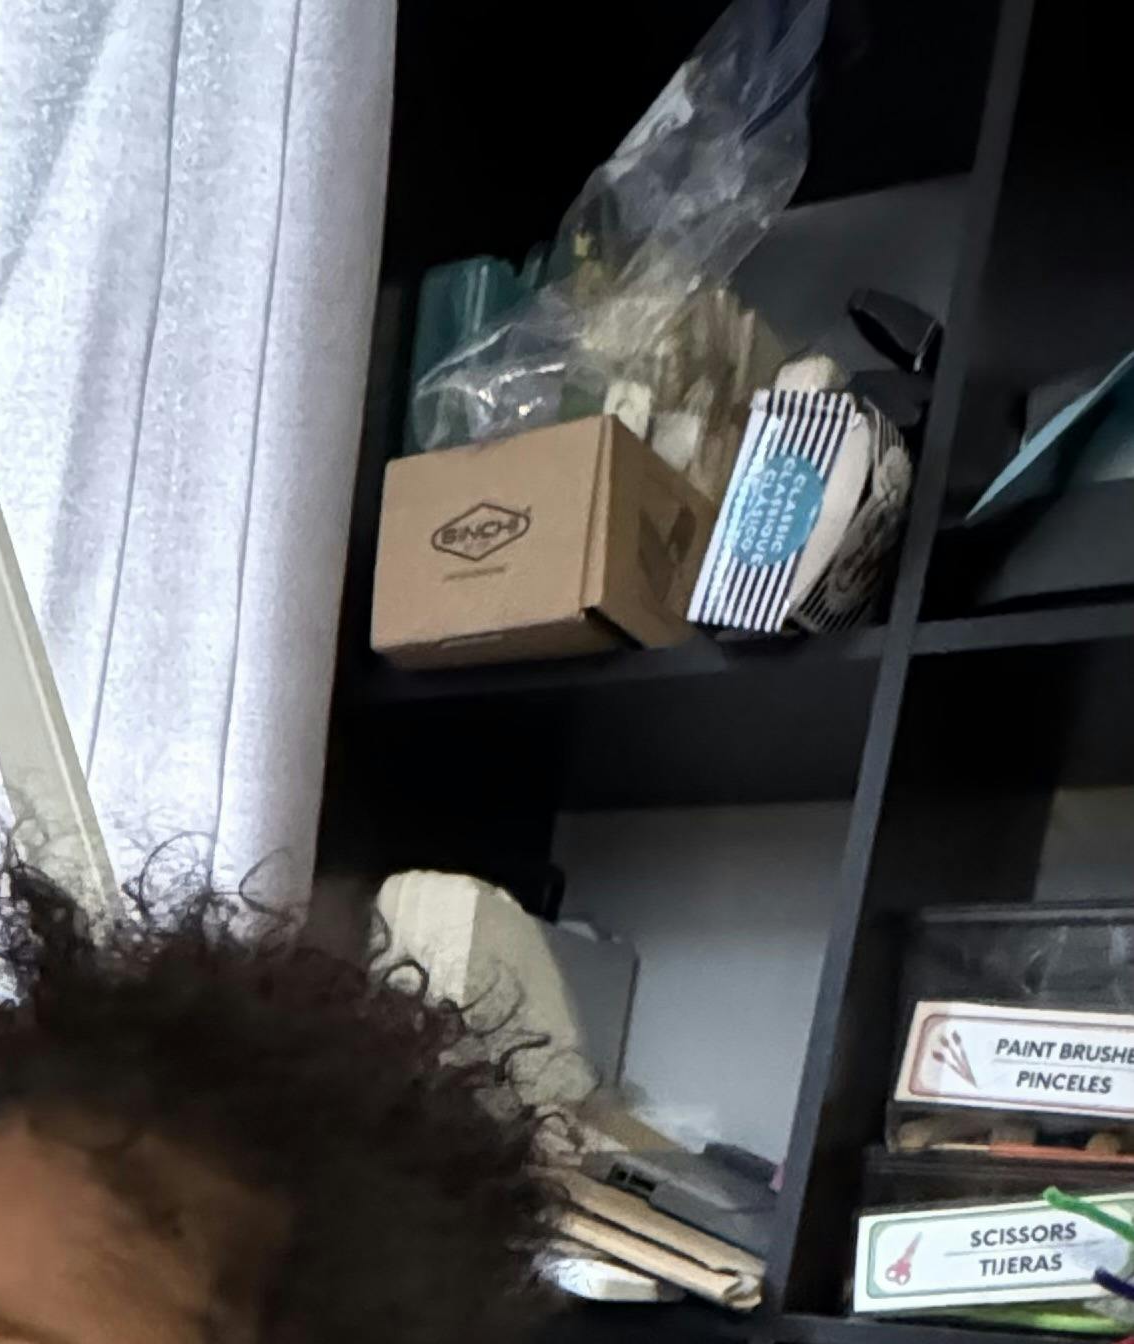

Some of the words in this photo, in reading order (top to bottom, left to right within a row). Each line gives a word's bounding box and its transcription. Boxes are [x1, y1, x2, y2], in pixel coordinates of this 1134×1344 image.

[995, 1038, 1057, 1060] PAINT
[1016, 1070, 1114, 1095] PINCELES
[970, 1222, 1078, 1248] SCISSORS
[979, 1253, 1064, 1278] TIJERAS
